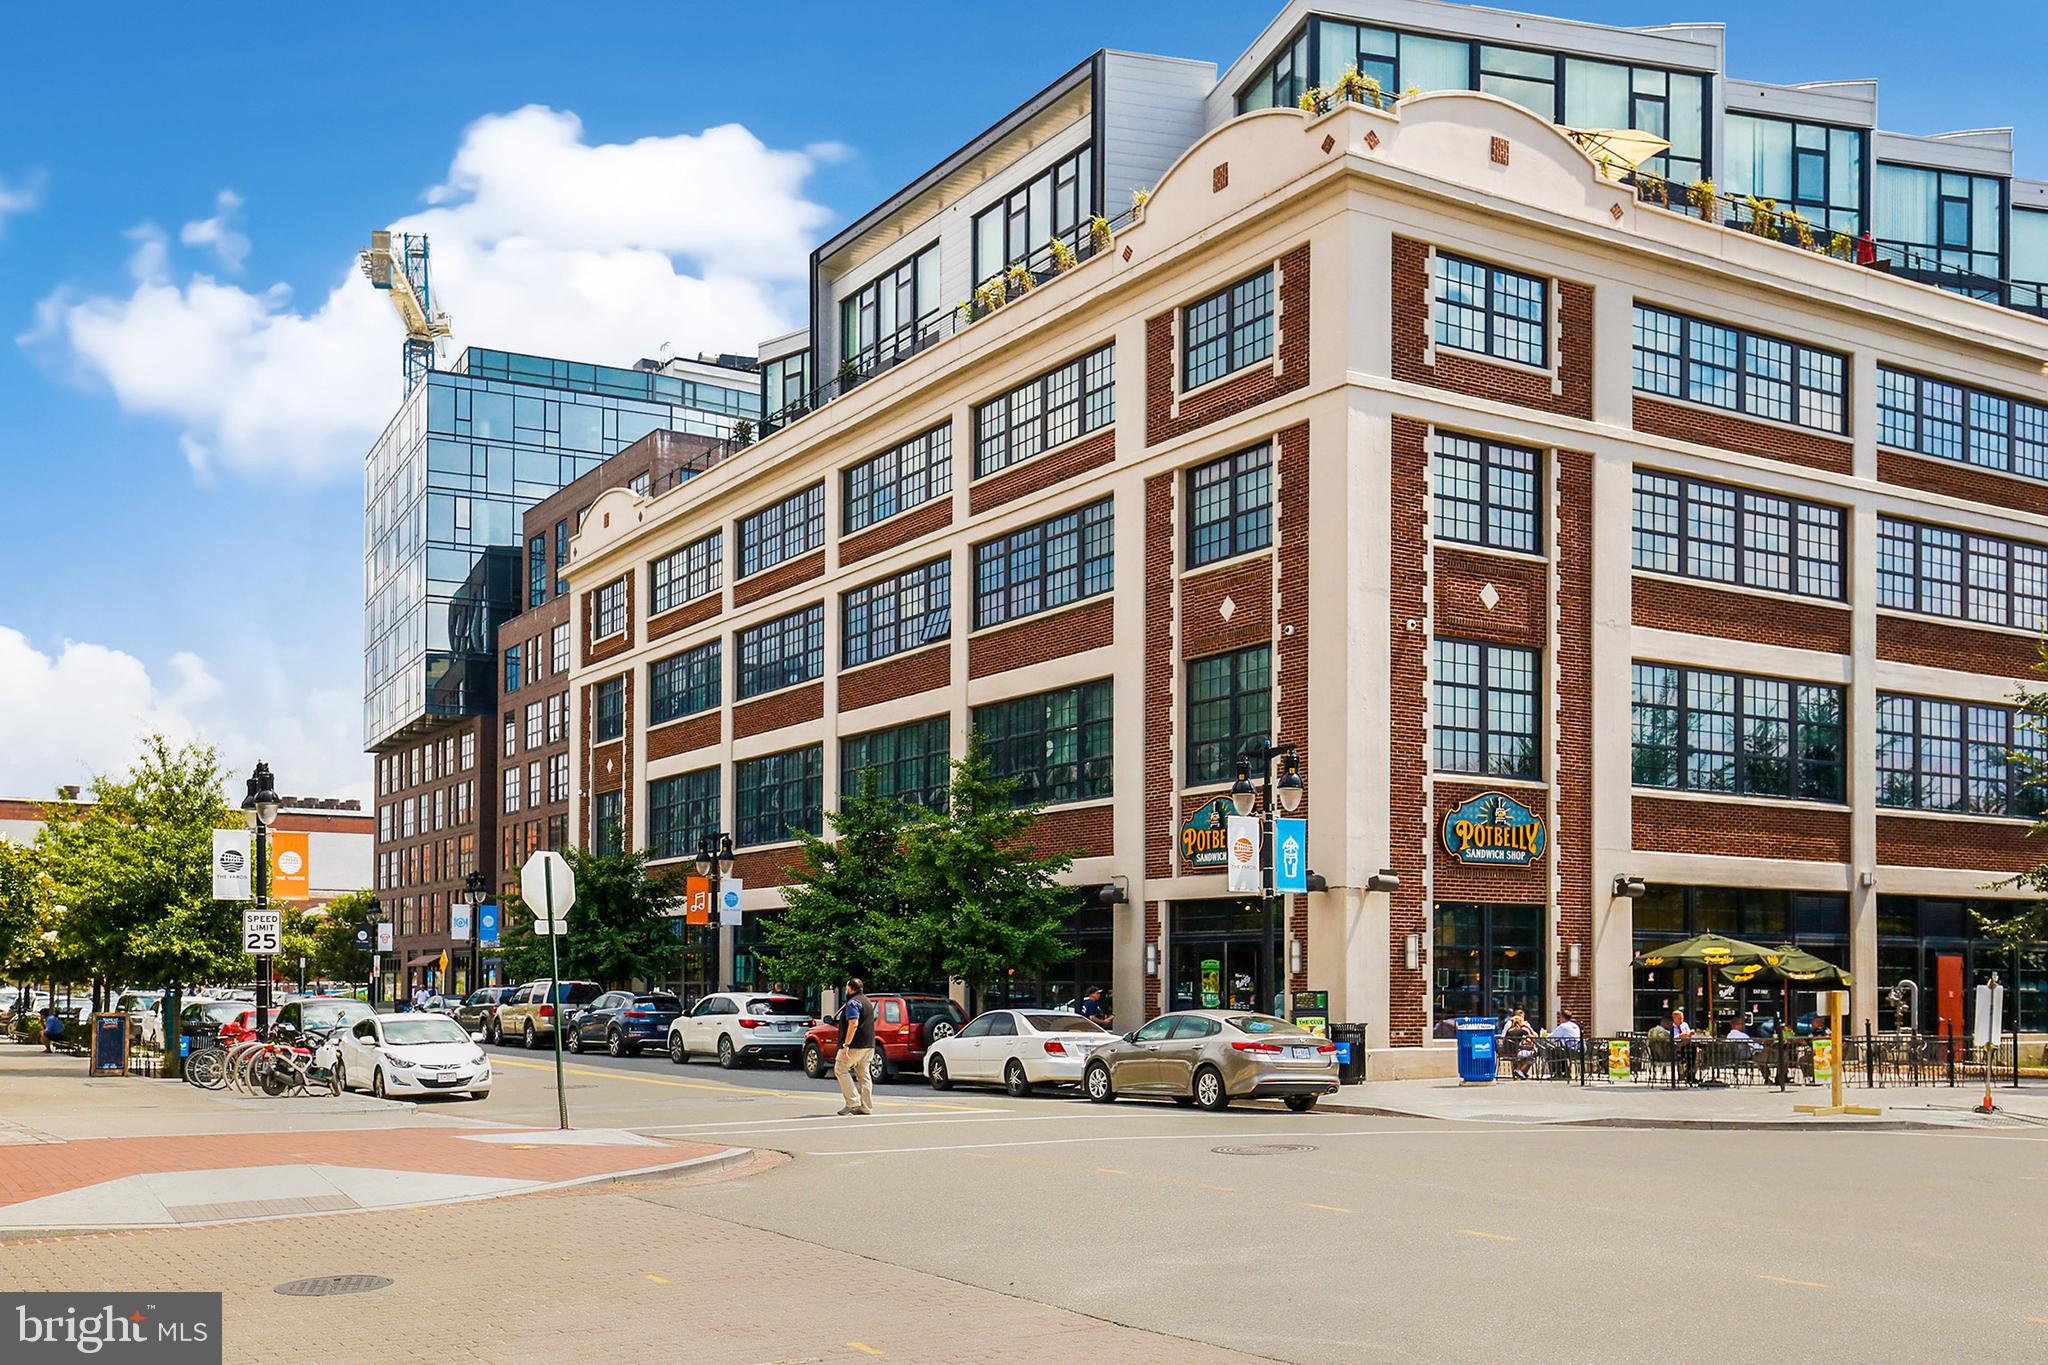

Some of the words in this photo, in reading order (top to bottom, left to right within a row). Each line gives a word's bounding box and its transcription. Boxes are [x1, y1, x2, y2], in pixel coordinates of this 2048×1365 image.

[1183, 828, 1228, 855] POTBE
[1456, 820, 1540, 854] POTBELLY
[1196, 852, 1227, 862] SANDWICH
[1466, 849, 1504, 859] SANDWICH
[1506, 851, 1526, 860] SHOP
[247, 915, 278, 923] SPEED
[247, 933, 276, 949] 25
